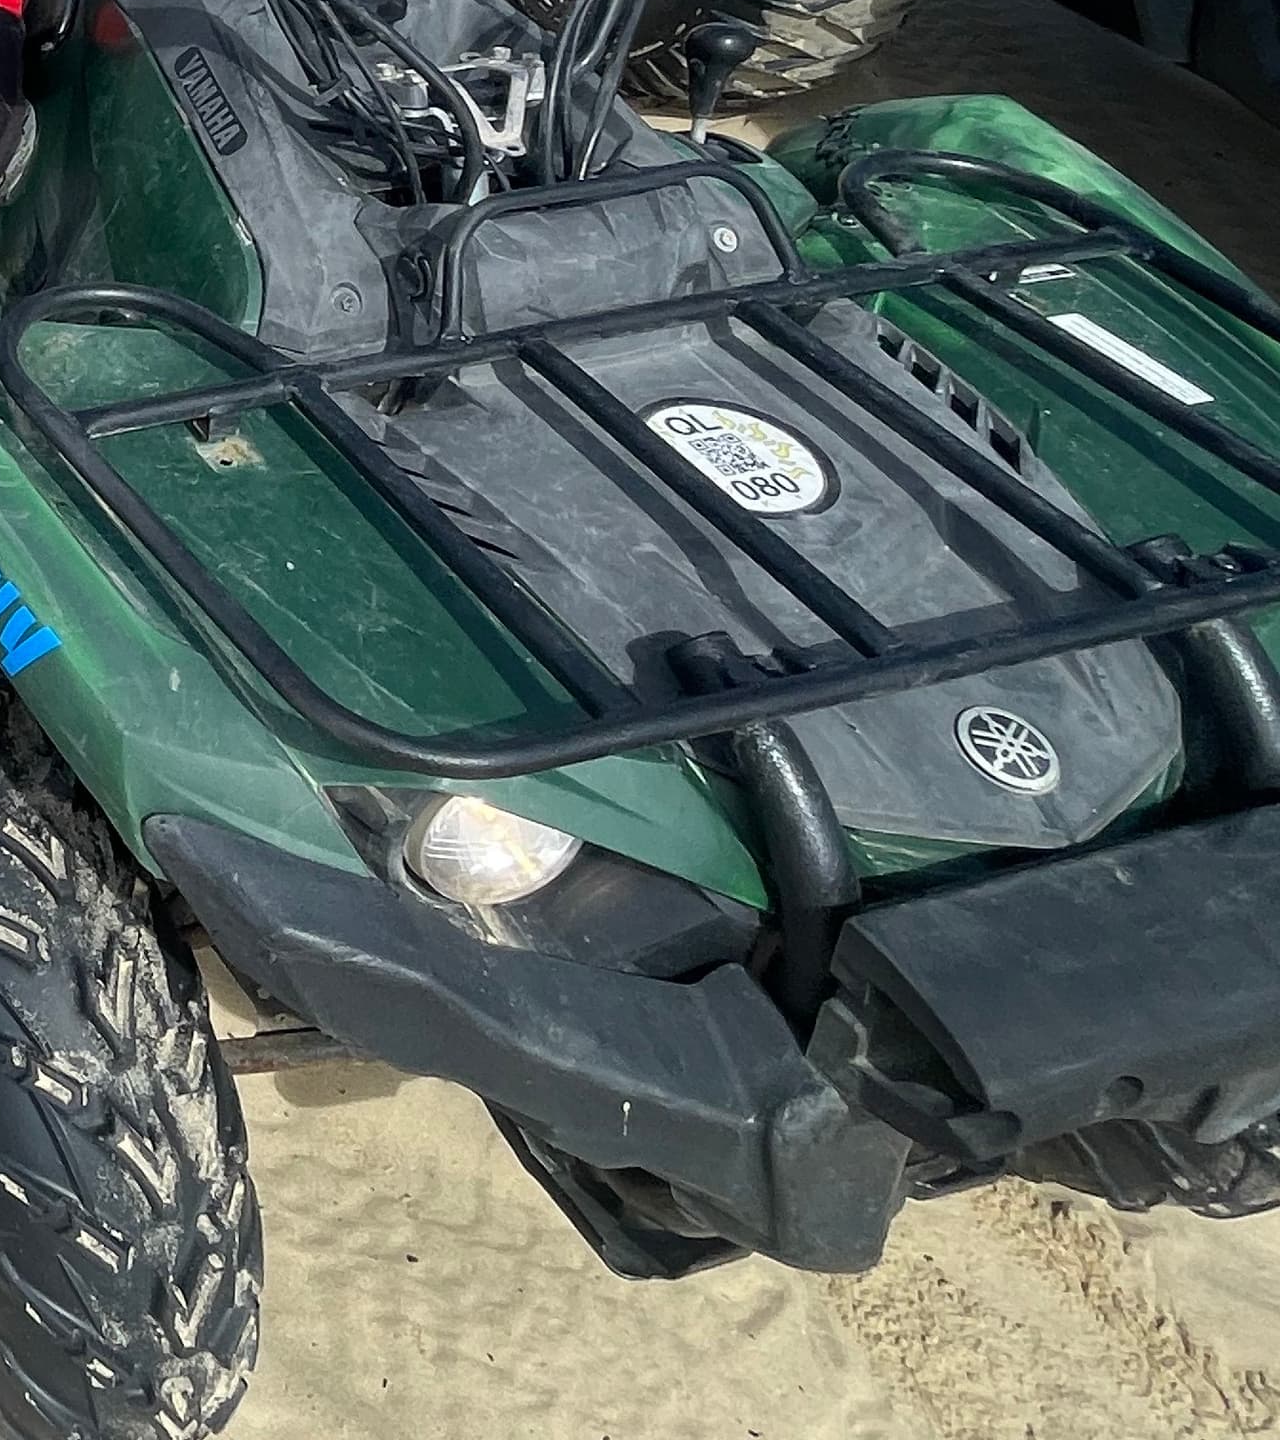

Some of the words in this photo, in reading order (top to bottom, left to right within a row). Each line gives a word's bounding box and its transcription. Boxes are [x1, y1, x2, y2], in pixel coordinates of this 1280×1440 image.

[178, 54, 241, 151] YAMAHA
[664, 414, 723, 436] QL
[731, 472, 800, 501] 080
